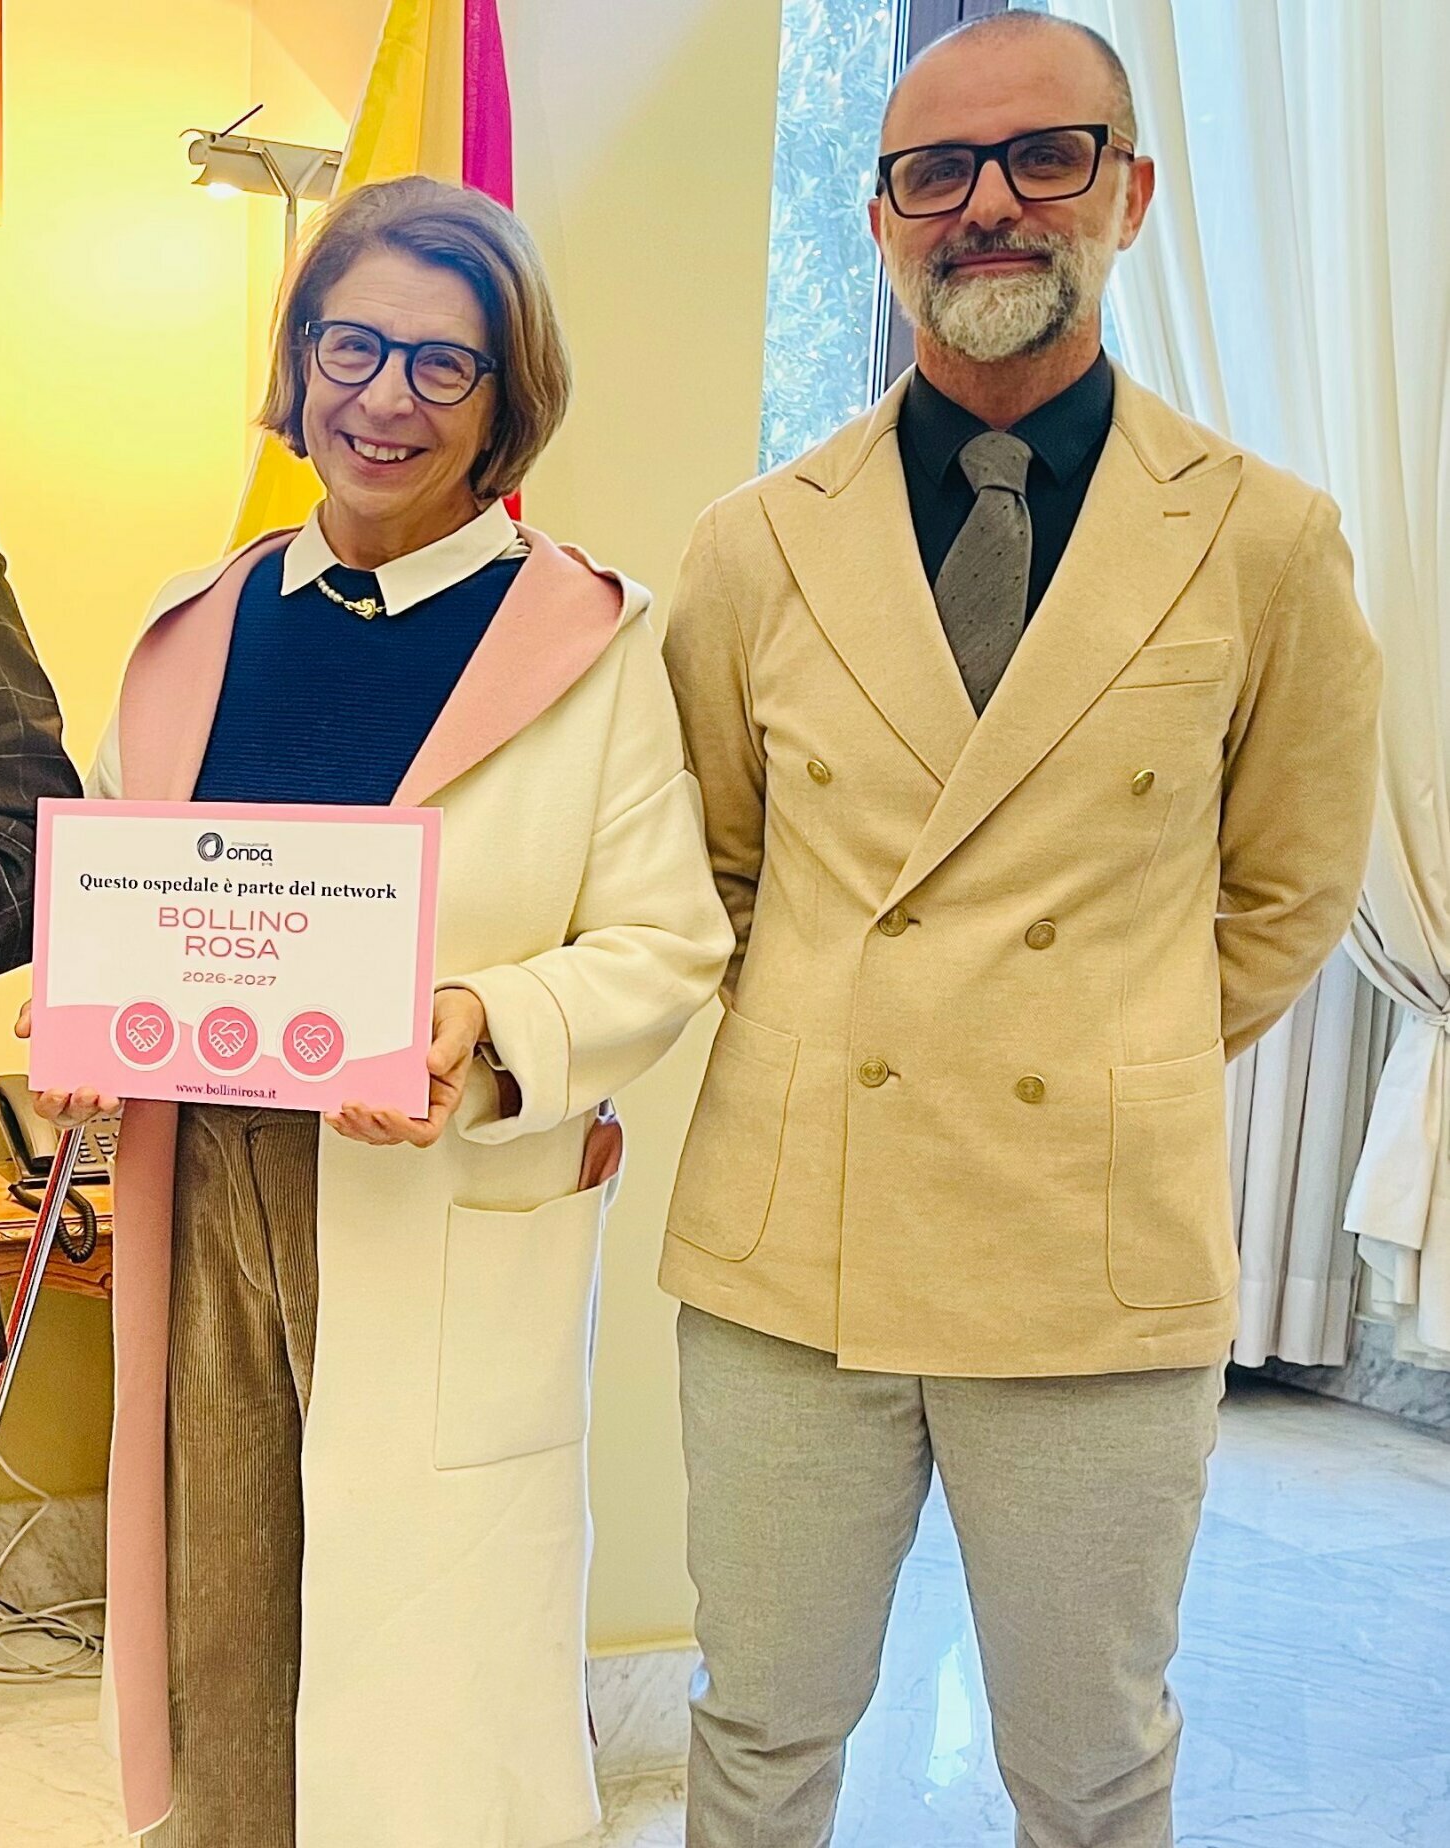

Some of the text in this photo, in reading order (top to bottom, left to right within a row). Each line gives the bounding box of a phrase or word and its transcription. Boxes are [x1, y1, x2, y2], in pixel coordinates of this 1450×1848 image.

[79, 873, 397, 899] Questo ospedale è parte del network
[158, 906, 309, 934] BOLLINO
[185, 935, 280, 961] ROSA
[182, 971, 277, 986] 2026-2027
[175, 1083, 278, 1099] www.bollinirosa.it
